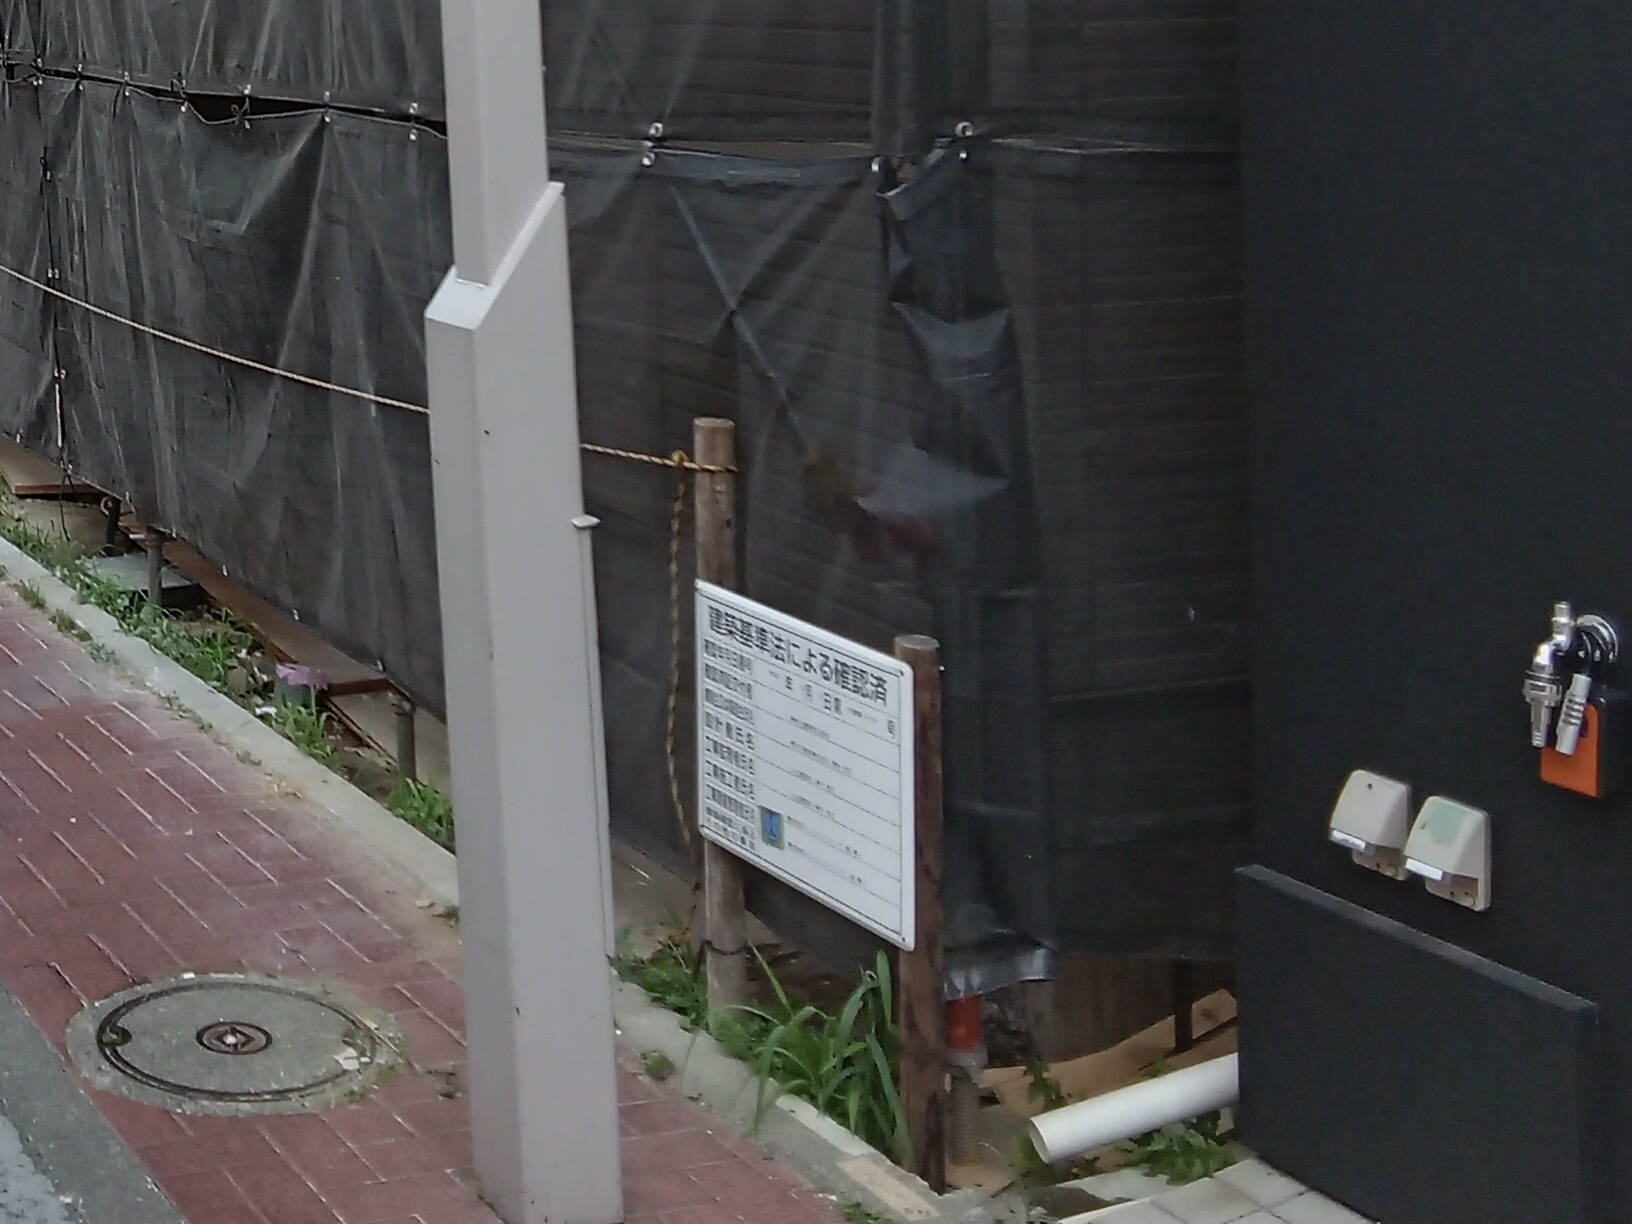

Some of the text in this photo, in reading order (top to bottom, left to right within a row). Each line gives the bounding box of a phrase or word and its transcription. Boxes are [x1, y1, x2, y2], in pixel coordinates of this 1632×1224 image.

[707, 604, 889, 707] 建築基準法による確認済
